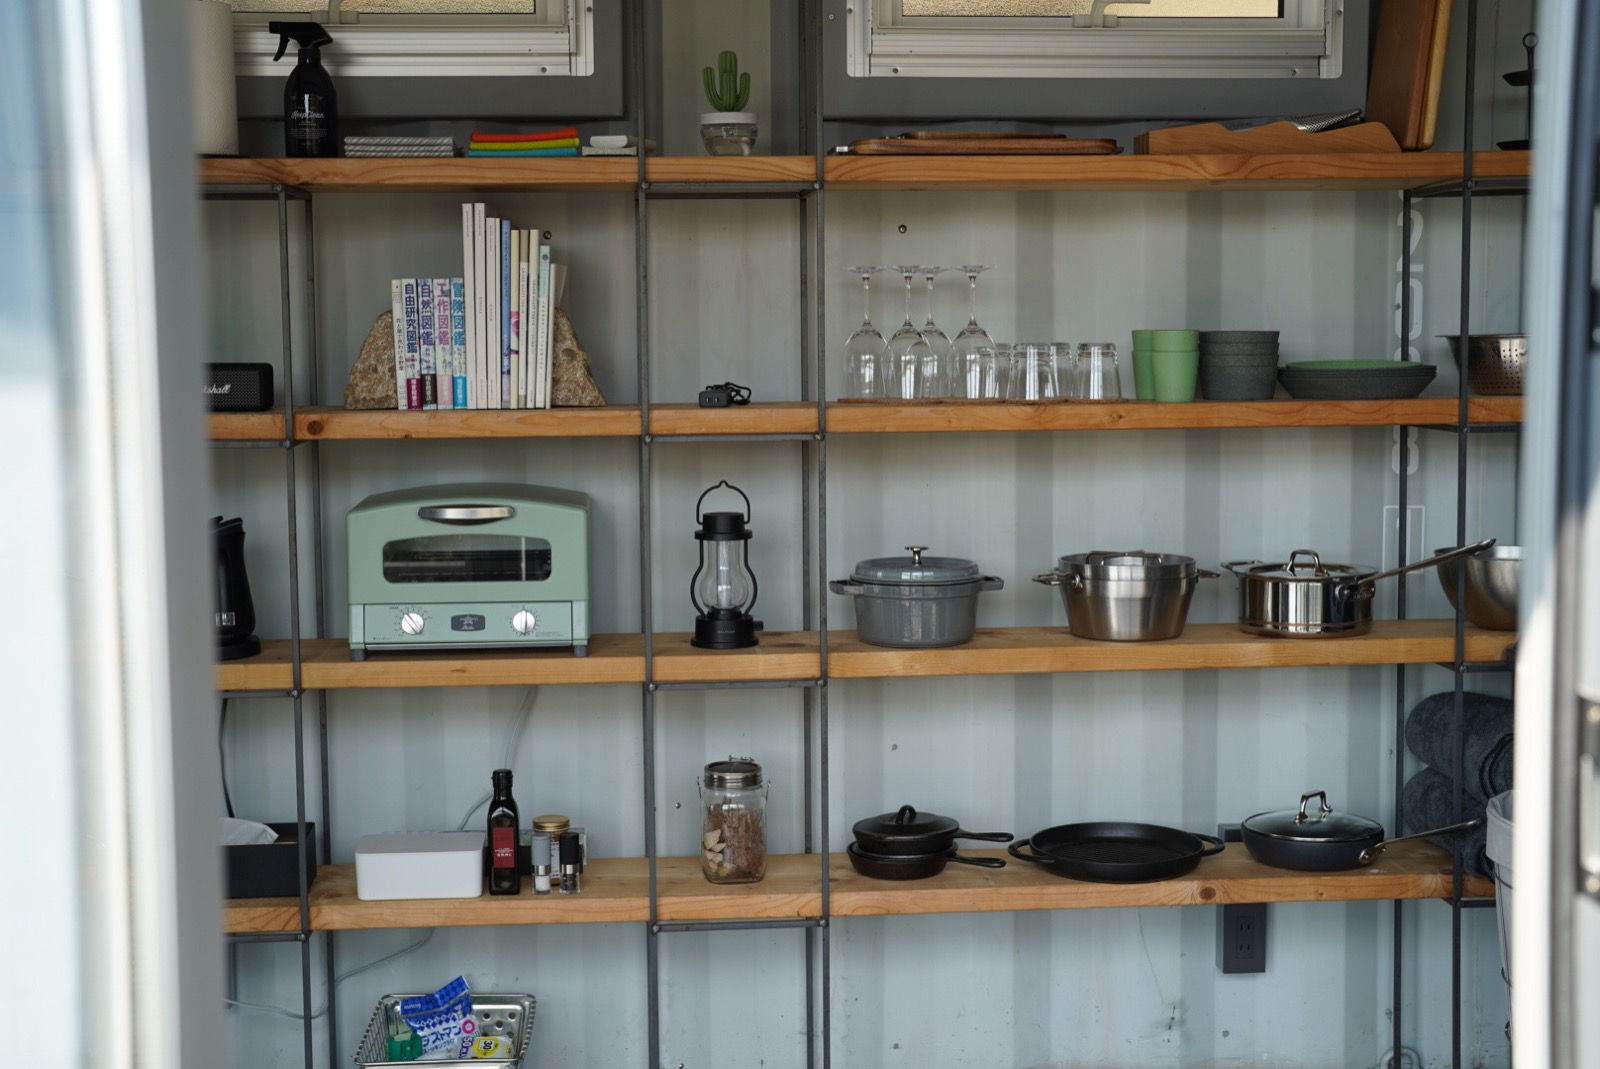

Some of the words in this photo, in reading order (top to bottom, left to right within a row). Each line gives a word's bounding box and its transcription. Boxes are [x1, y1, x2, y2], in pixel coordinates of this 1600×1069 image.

[404, 283, 418, 354] 自由研究図鑑
[420, 282, 434, 347] 自然図鑑
[436, 282, 450, 346] 工作図鑑
[452, 282, 465, 347] 冒険図鑑
[483, 1040, 493, 1050] 30
